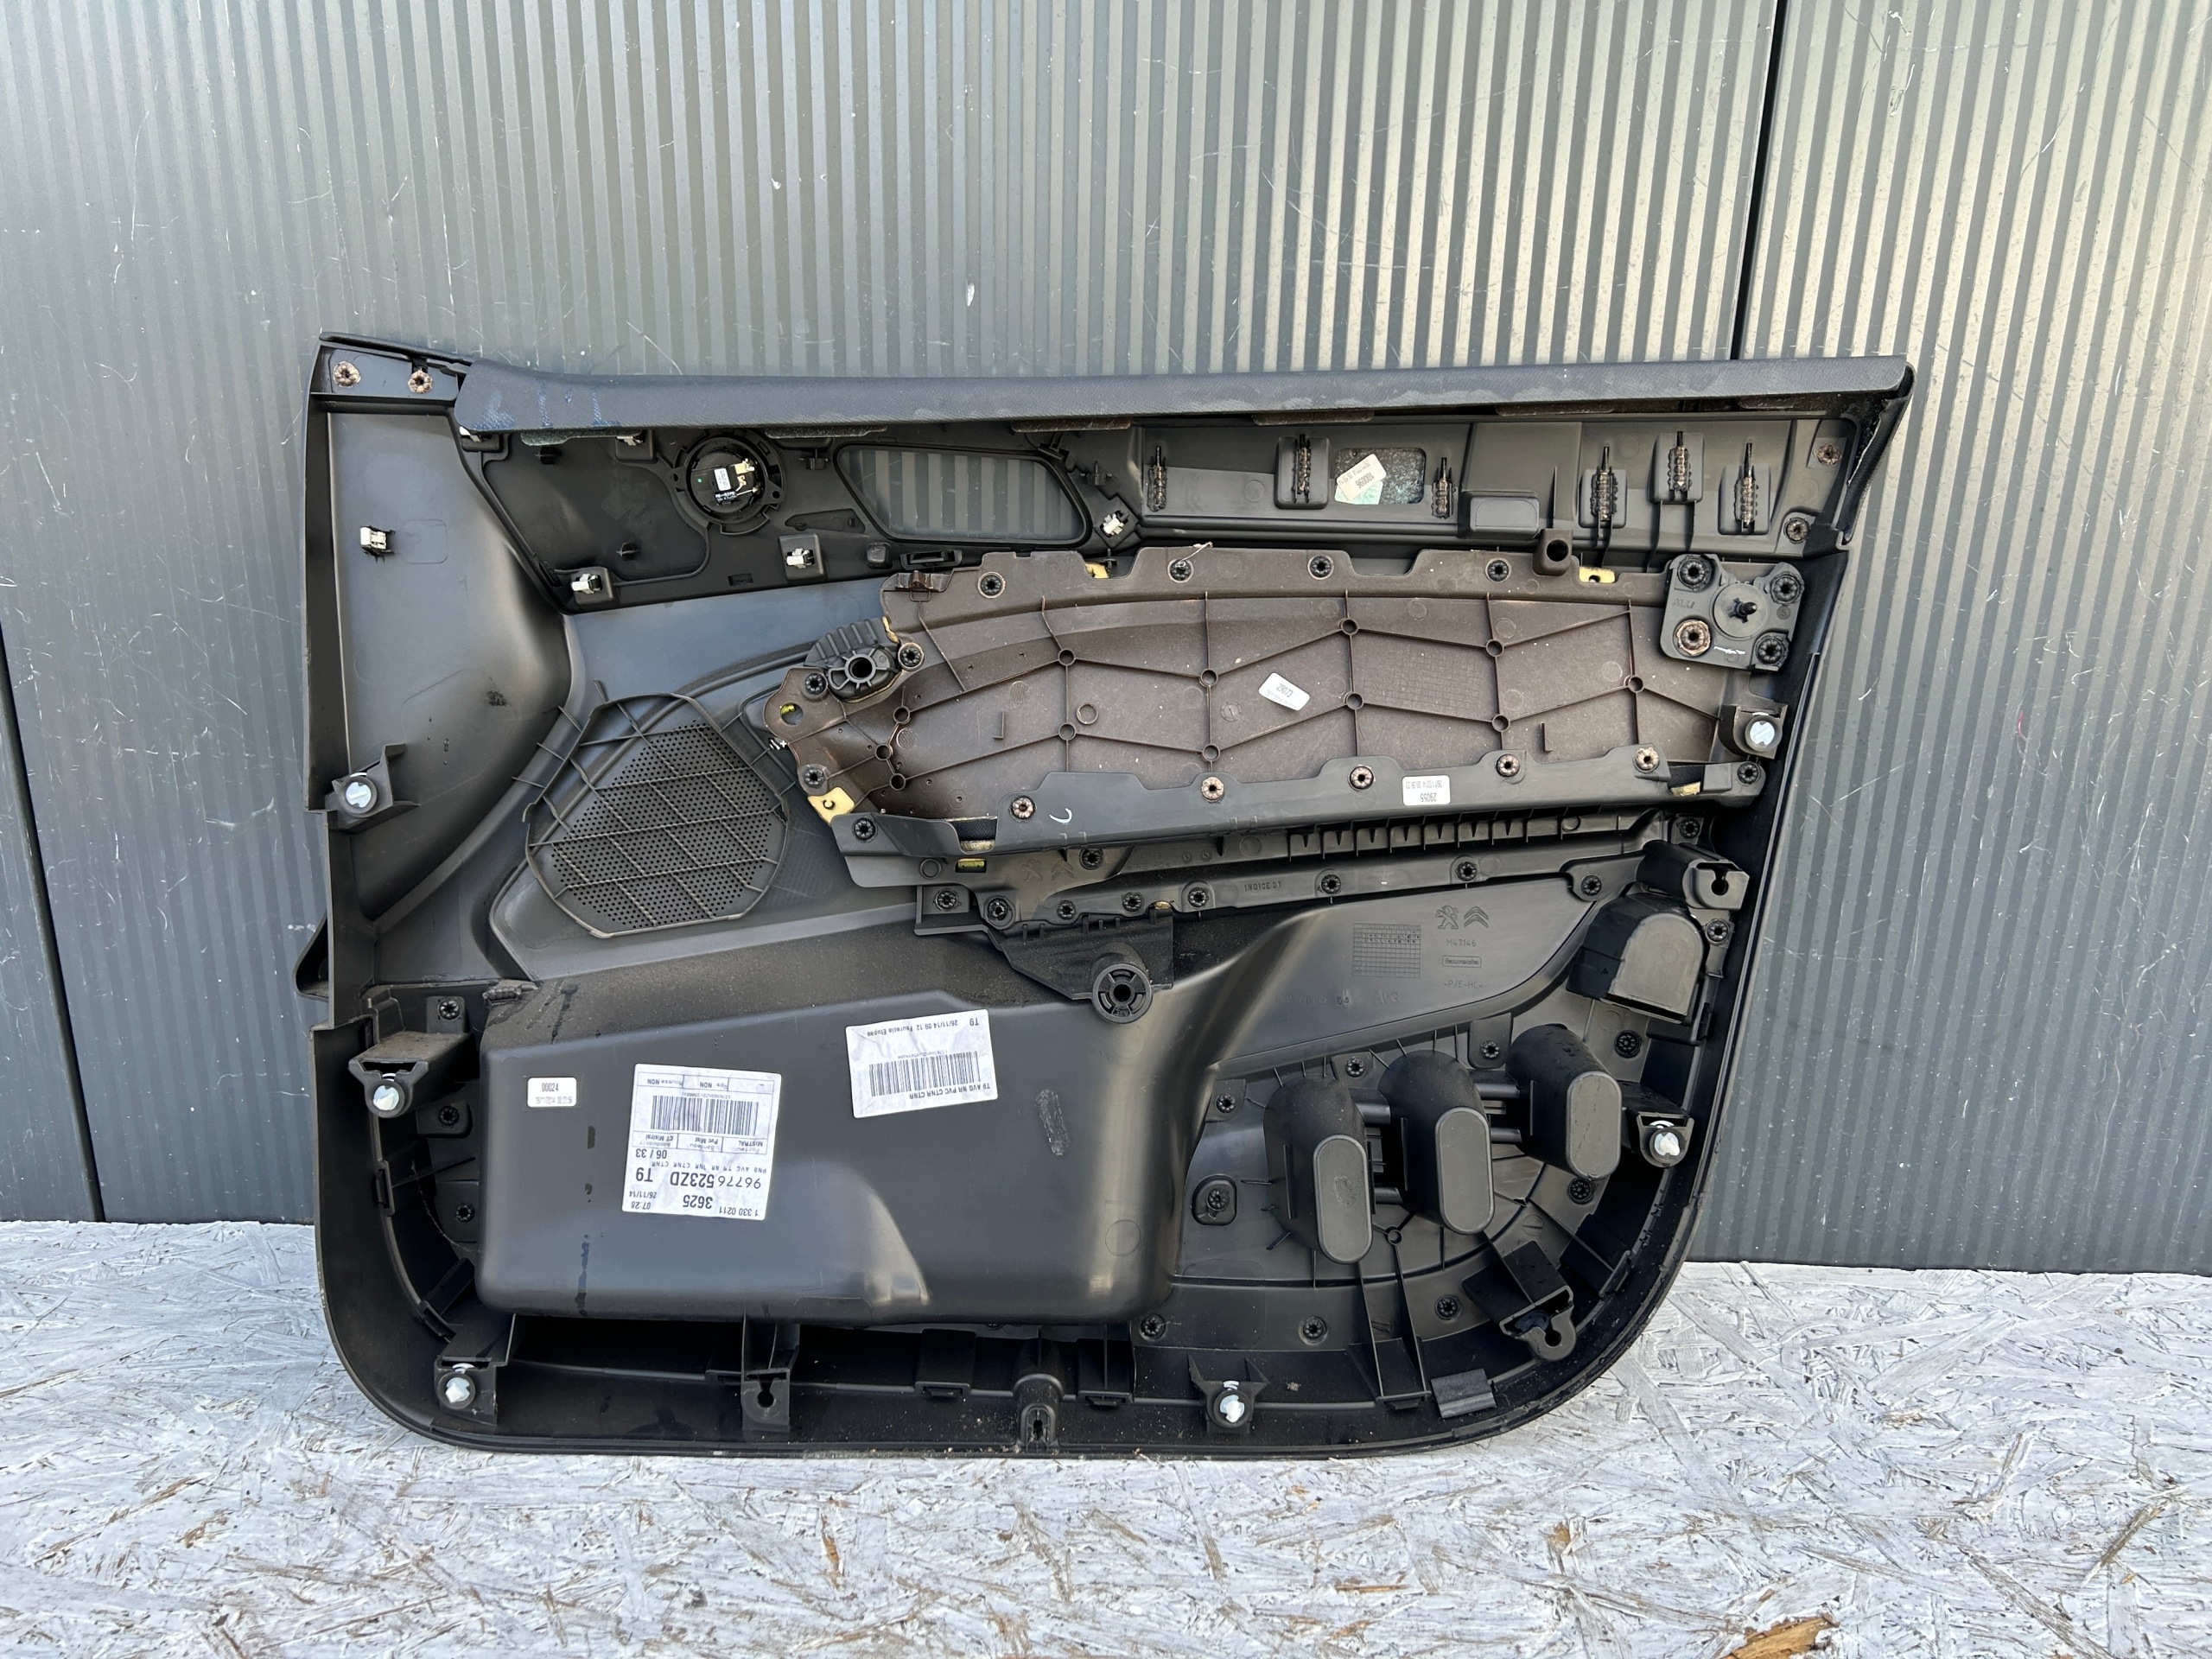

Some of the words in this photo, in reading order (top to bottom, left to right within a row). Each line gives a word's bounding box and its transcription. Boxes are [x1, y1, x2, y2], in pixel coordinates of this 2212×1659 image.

[1276, 683, 1294, 698] 29073
[1446, 938, 1477, 948] M47146
[933, 1020, 957, 1028] 26/11/14
[889, 1026, 912, 1034] Faurecia
[636, 1148, 647, 1158] 33
[657, 1149, 667, 1159] 06
[636, 1167, 653, 1182] T9
[632, 1201, 651, 1210] 07:28
[683, 1195, 713, 1209] 3625
[719, 1206, 736, 1215] 0211
